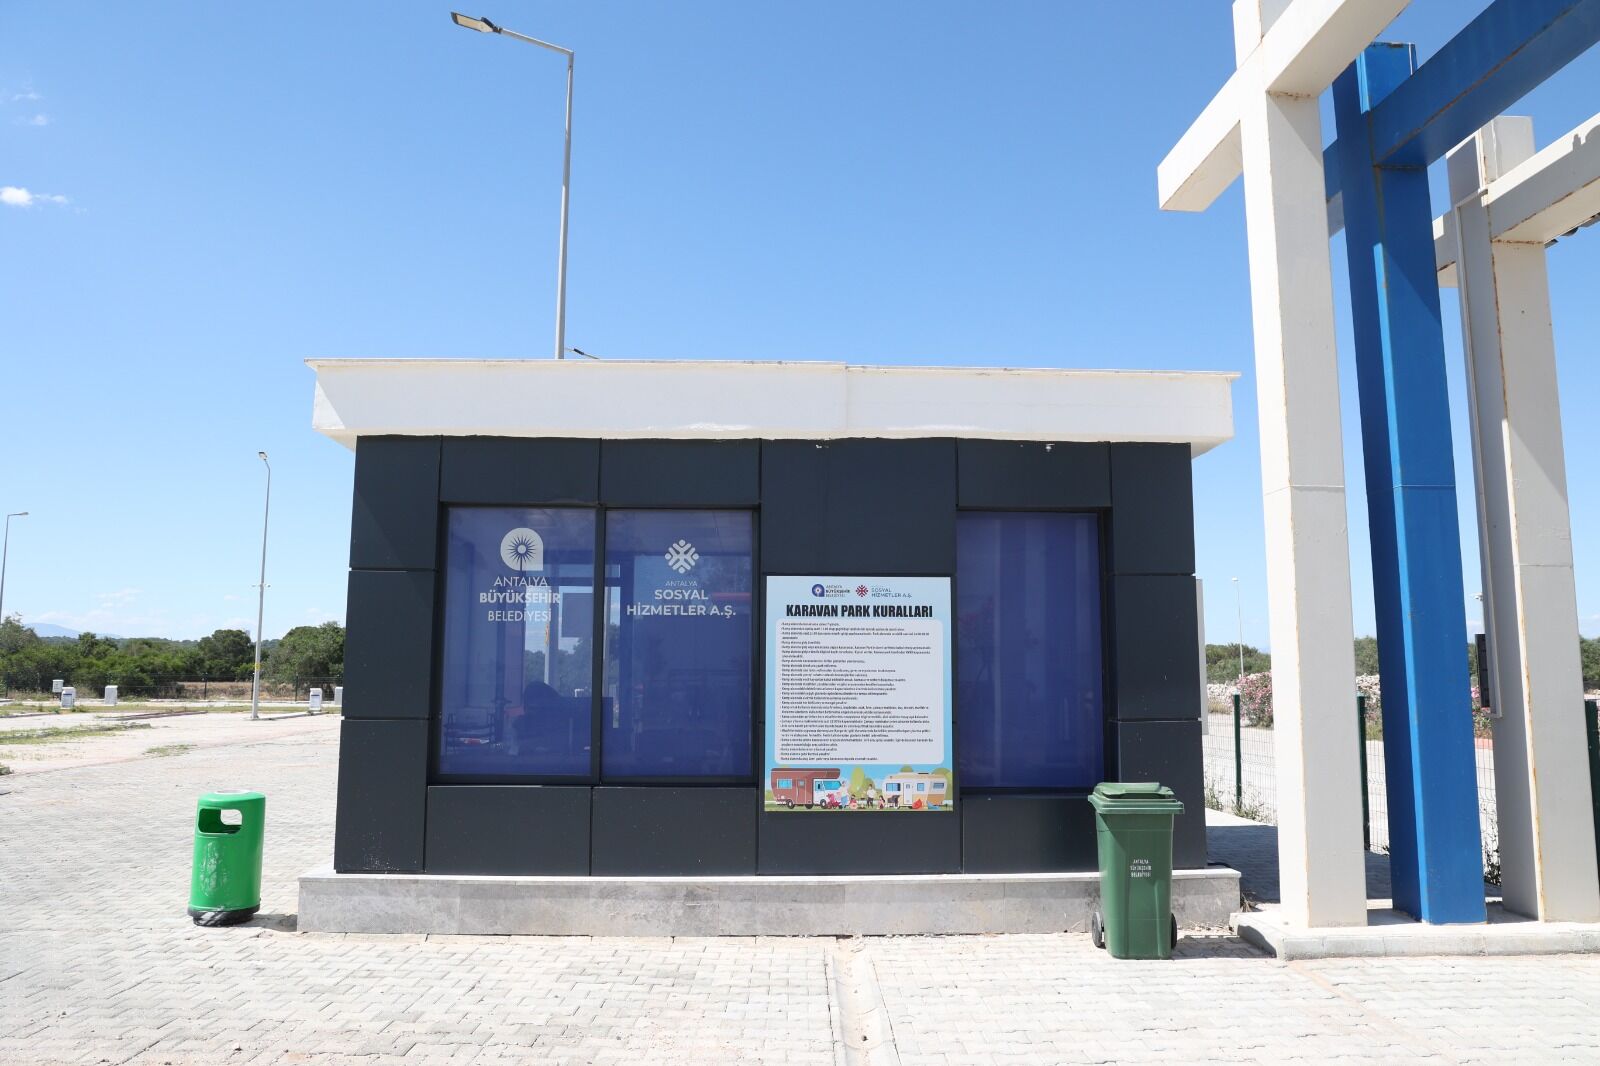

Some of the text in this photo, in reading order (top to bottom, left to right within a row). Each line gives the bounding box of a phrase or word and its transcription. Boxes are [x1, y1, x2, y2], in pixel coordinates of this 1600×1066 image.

[493, 576, 548, 587] ANTALYA
[479, 590, 561, 607] BÜYÜKŞEHİR
[654, 589, 709, 600] SOSYAL
[488, 608, 552, 622] BELEDİYESİ
[626, 601, 737, 619] HİZMETLER A.Ş.
[786, 604, 933, 618] KARAVAN PARK KURALLARI
